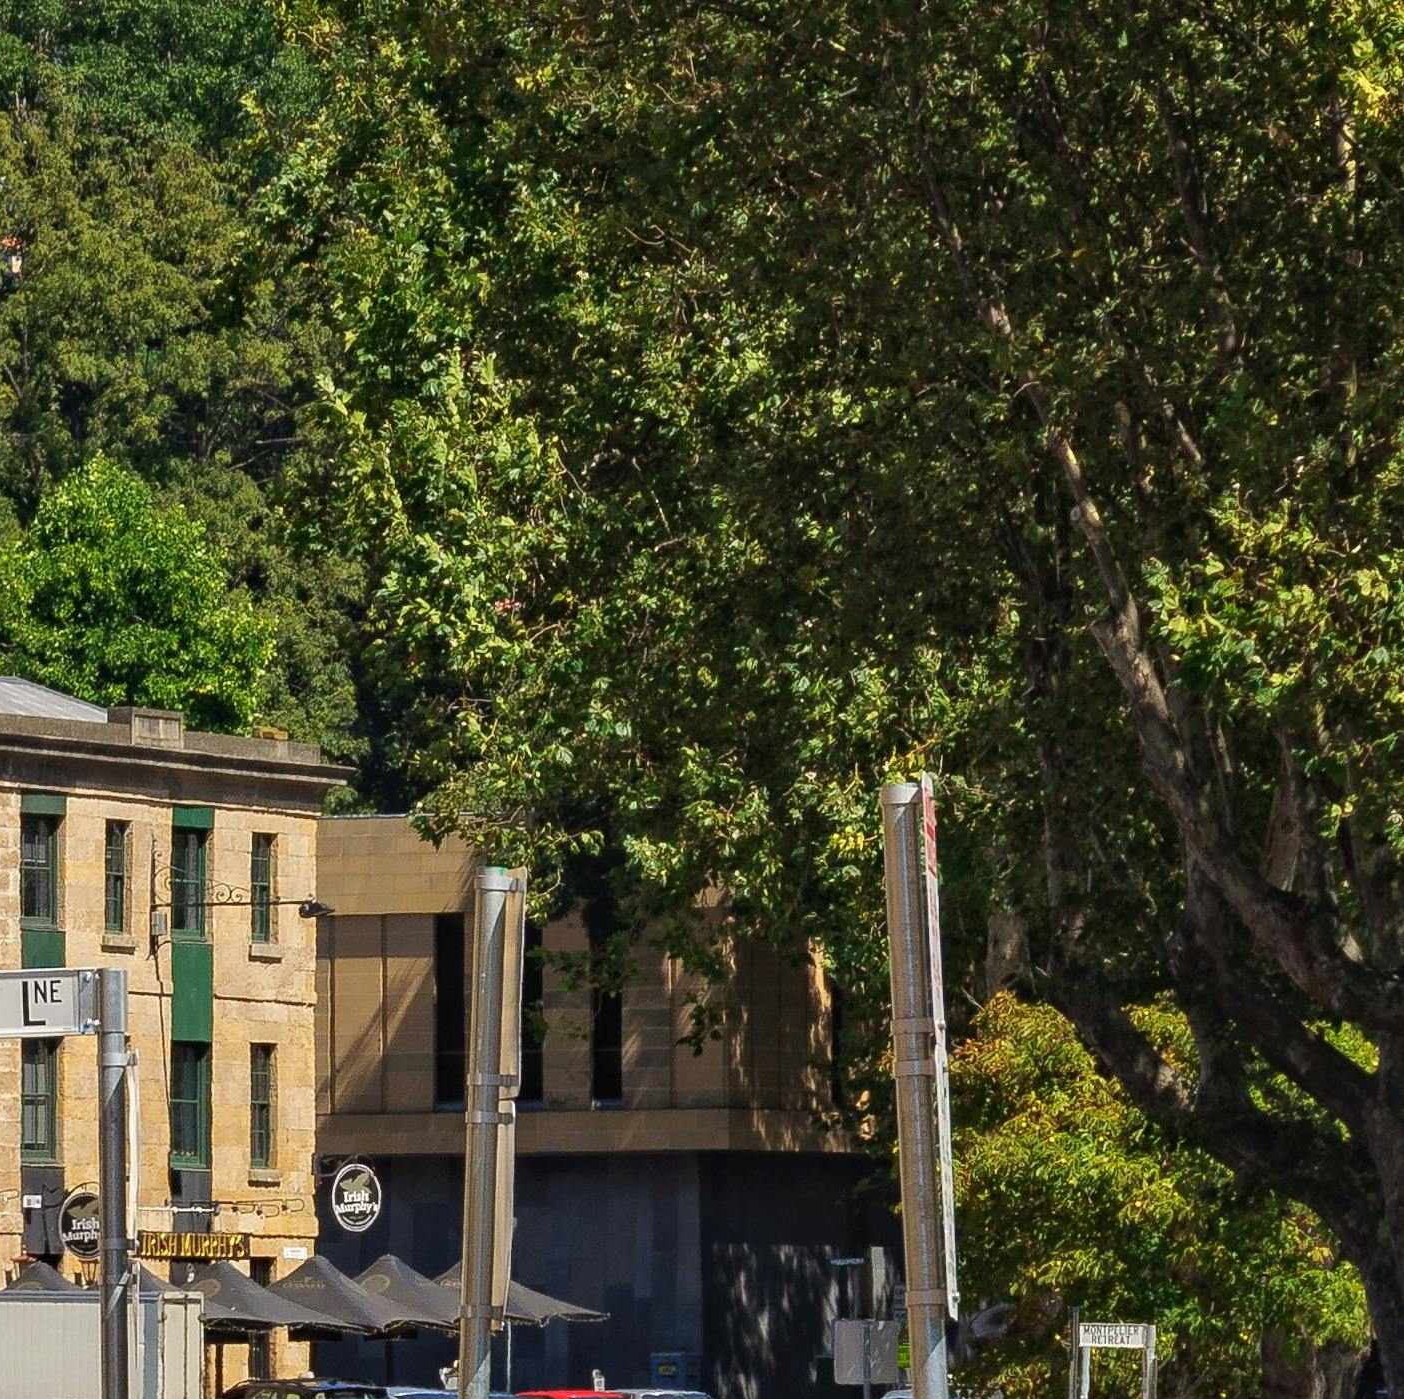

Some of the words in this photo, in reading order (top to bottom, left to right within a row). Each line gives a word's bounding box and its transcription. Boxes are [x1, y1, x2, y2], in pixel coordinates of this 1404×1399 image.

[342, 1190, 370, 1203] Irish
[335, 1200, 380, 1215] Murphy's
[140, 1231, 177, 1258] IRISH
[180, 1232, 245, 1259] MURPHY'S
[1091, 1335, 1131, 1345] RETREAT
